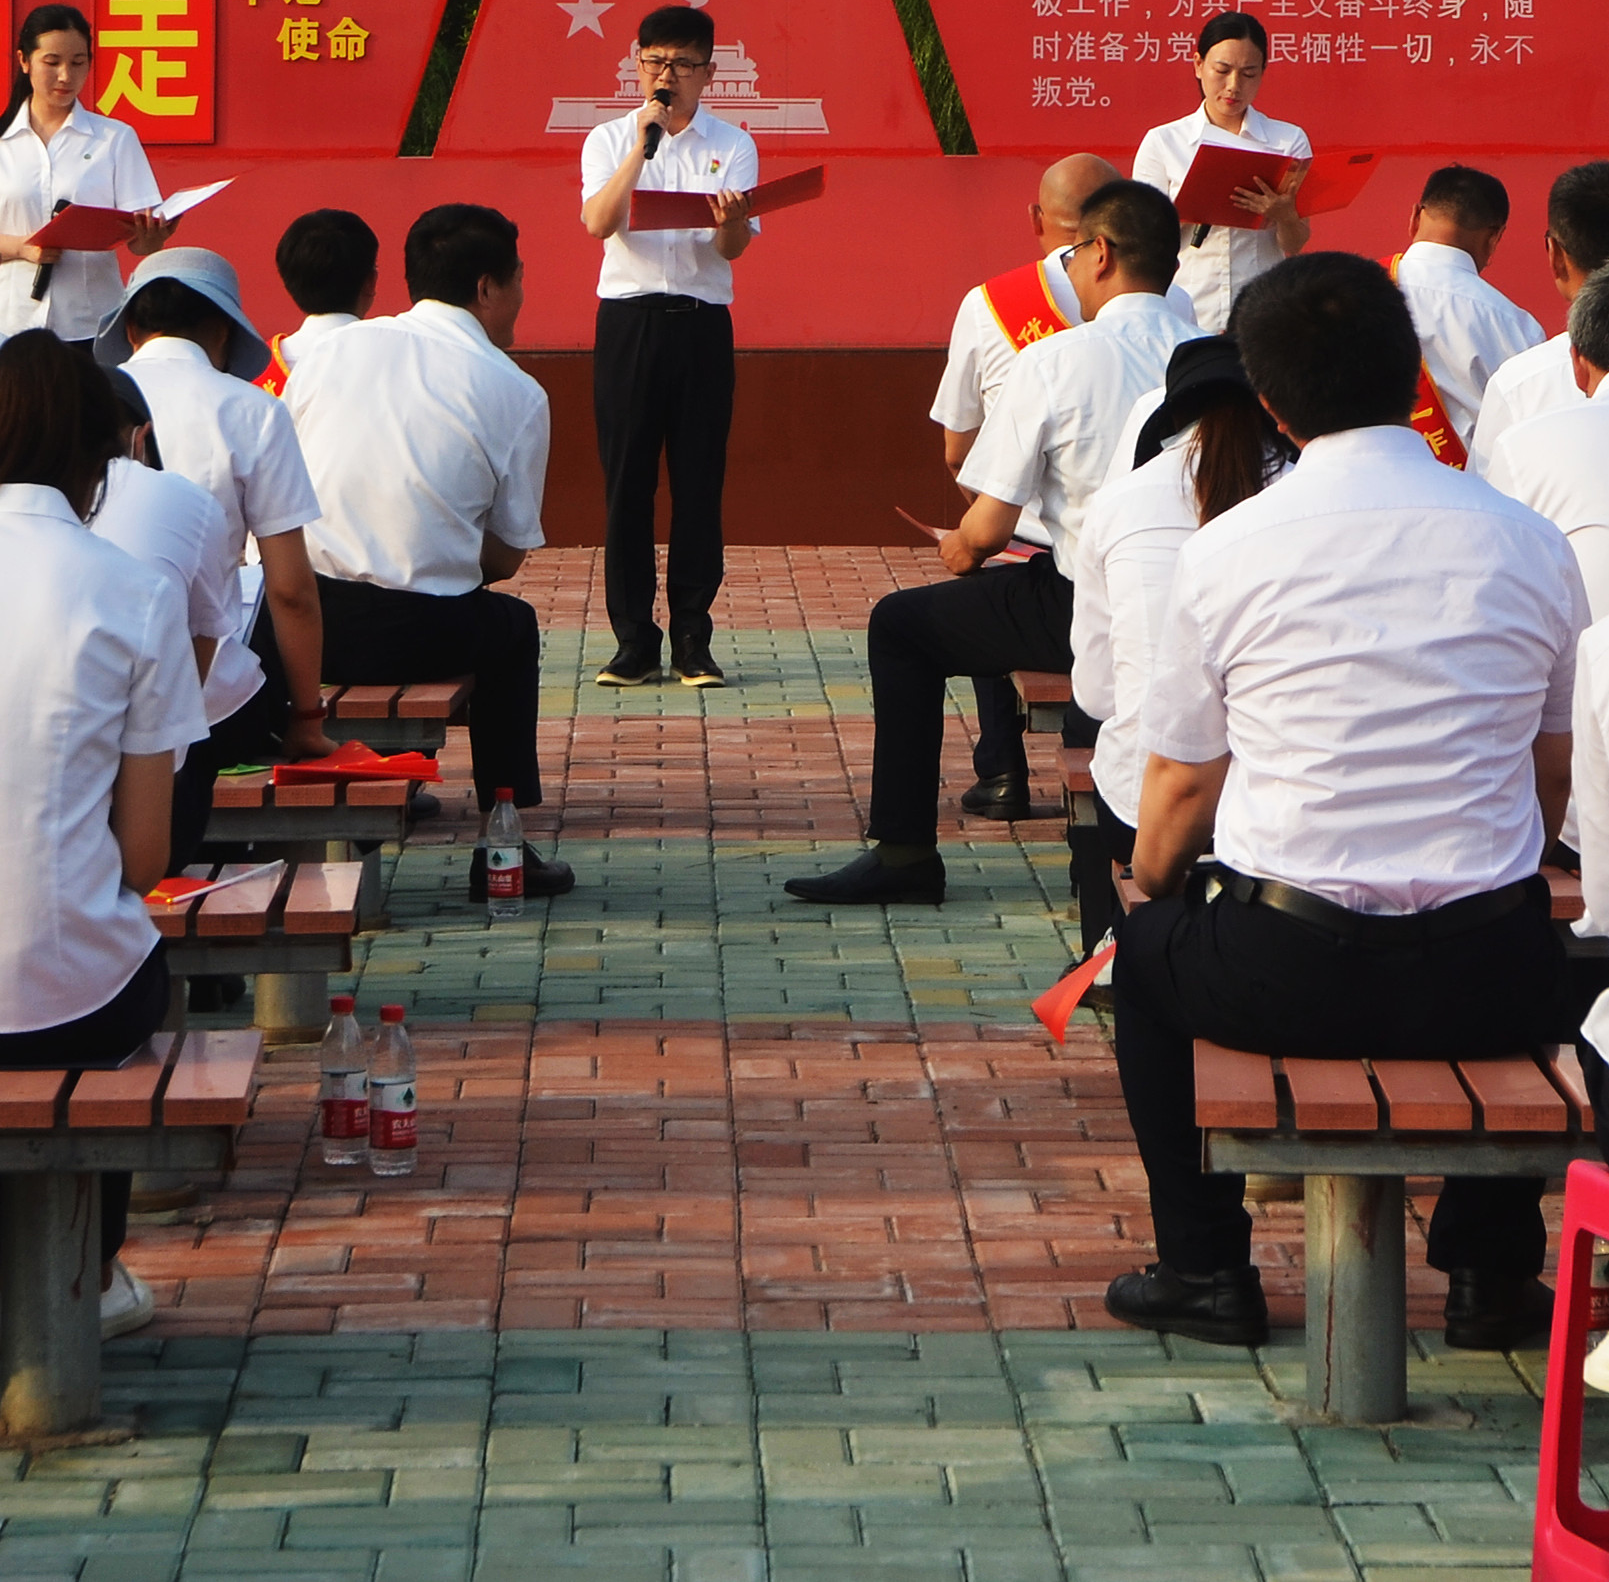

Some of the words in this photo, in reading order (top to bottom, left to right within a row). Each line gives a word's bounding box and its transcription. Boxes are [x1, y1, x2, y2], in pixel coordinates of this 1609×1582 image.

[276, 16, 370, 61] 使命
[1032, 30, 1535, 66] 时准备为党民牺牲一切，永不
